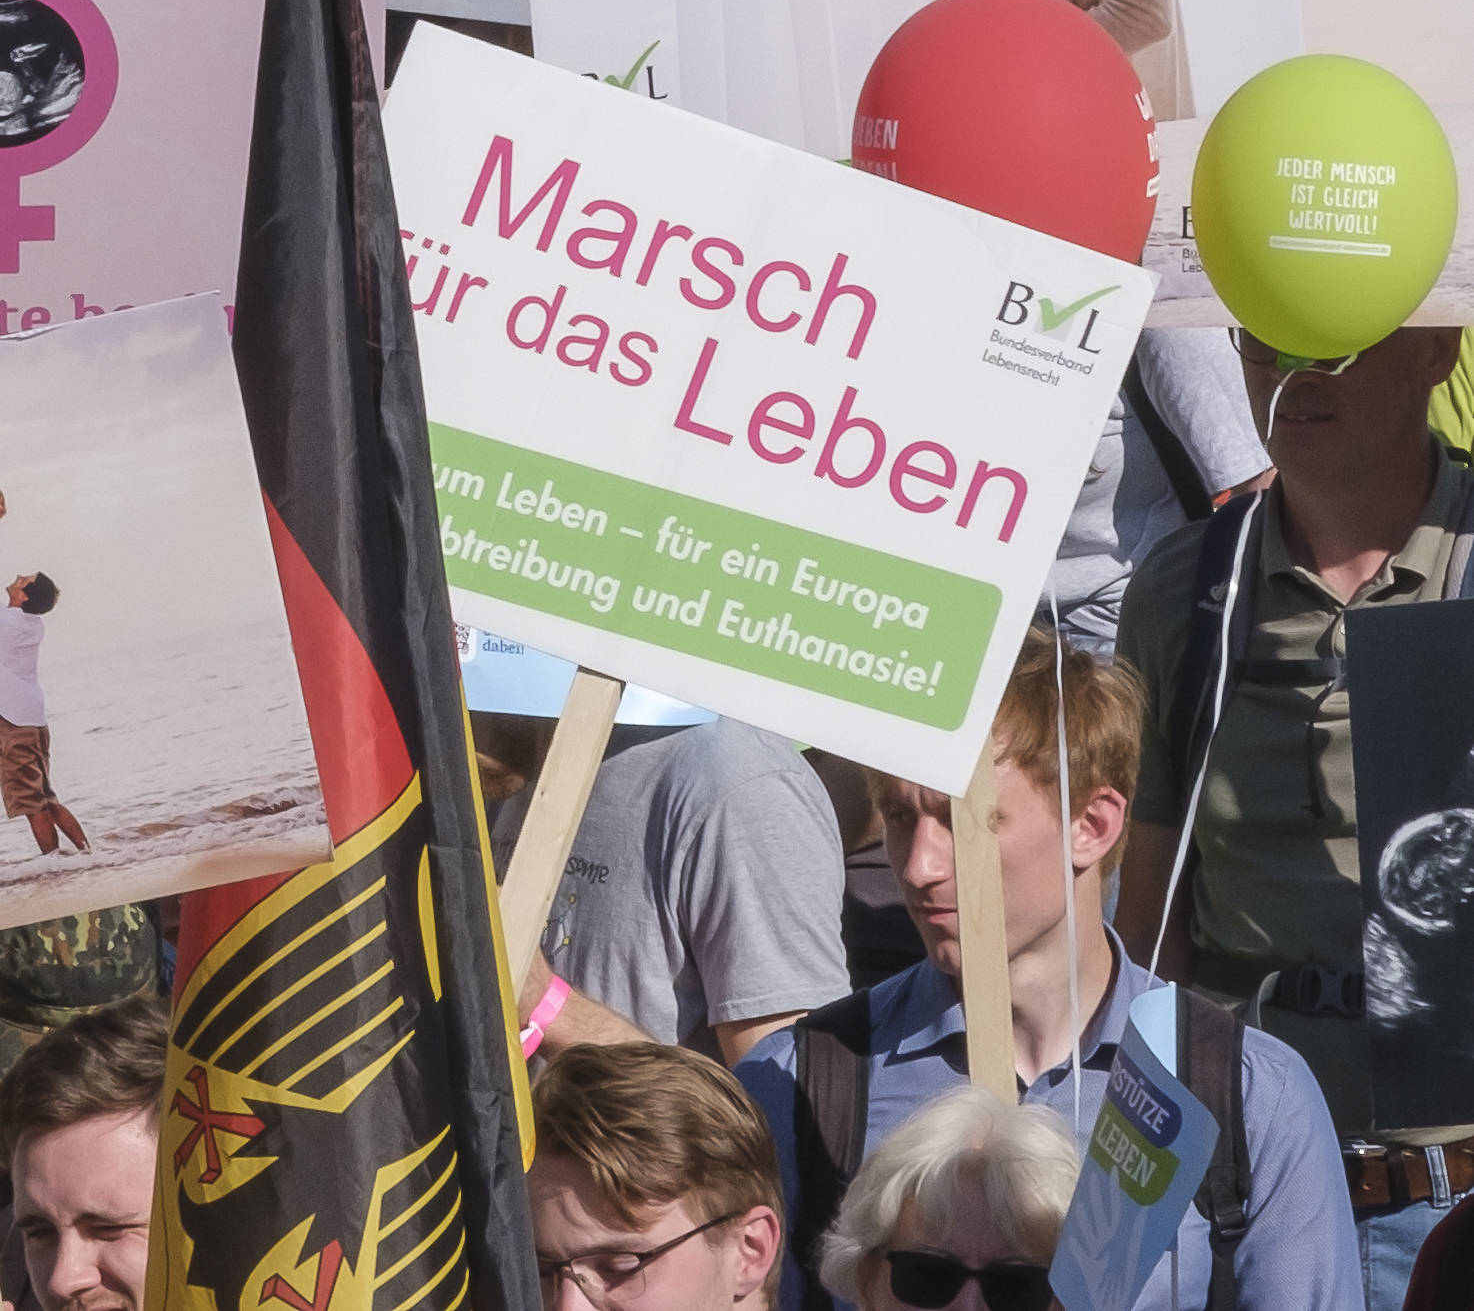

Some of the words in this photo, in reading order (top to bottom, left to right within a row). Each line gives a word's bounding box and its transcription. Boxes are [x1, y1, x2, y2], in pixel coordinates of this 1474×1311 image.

[1277, 157, 1326, 184] JEDER
[1332, 160, 1396, 187] MENSCH
[1291, 182, 1319, 208] IST
[1323, 185, 1379, 209] GLEICH
[1289, 209, 1378, 236] WERTVOLL!
[462, 134, 879, 362] Marsch
[981, 349, 1060, 388] Lebensrecht
[989, 329, 1094, 377] Bundesverband
[506, 284, 659, 388] das
[673, 337, 1031, 545] Leben
[495, 470, 609, 538] Leben
[656, 515, 713, 565] für
[721, 541, 779, 587] ein
[792, 557, 930, 632] Europa
[438, 522, 620, 612] btreibung
[631, 581, 706, 629] und
[717, 585, 944, 698] Euthanasie!
